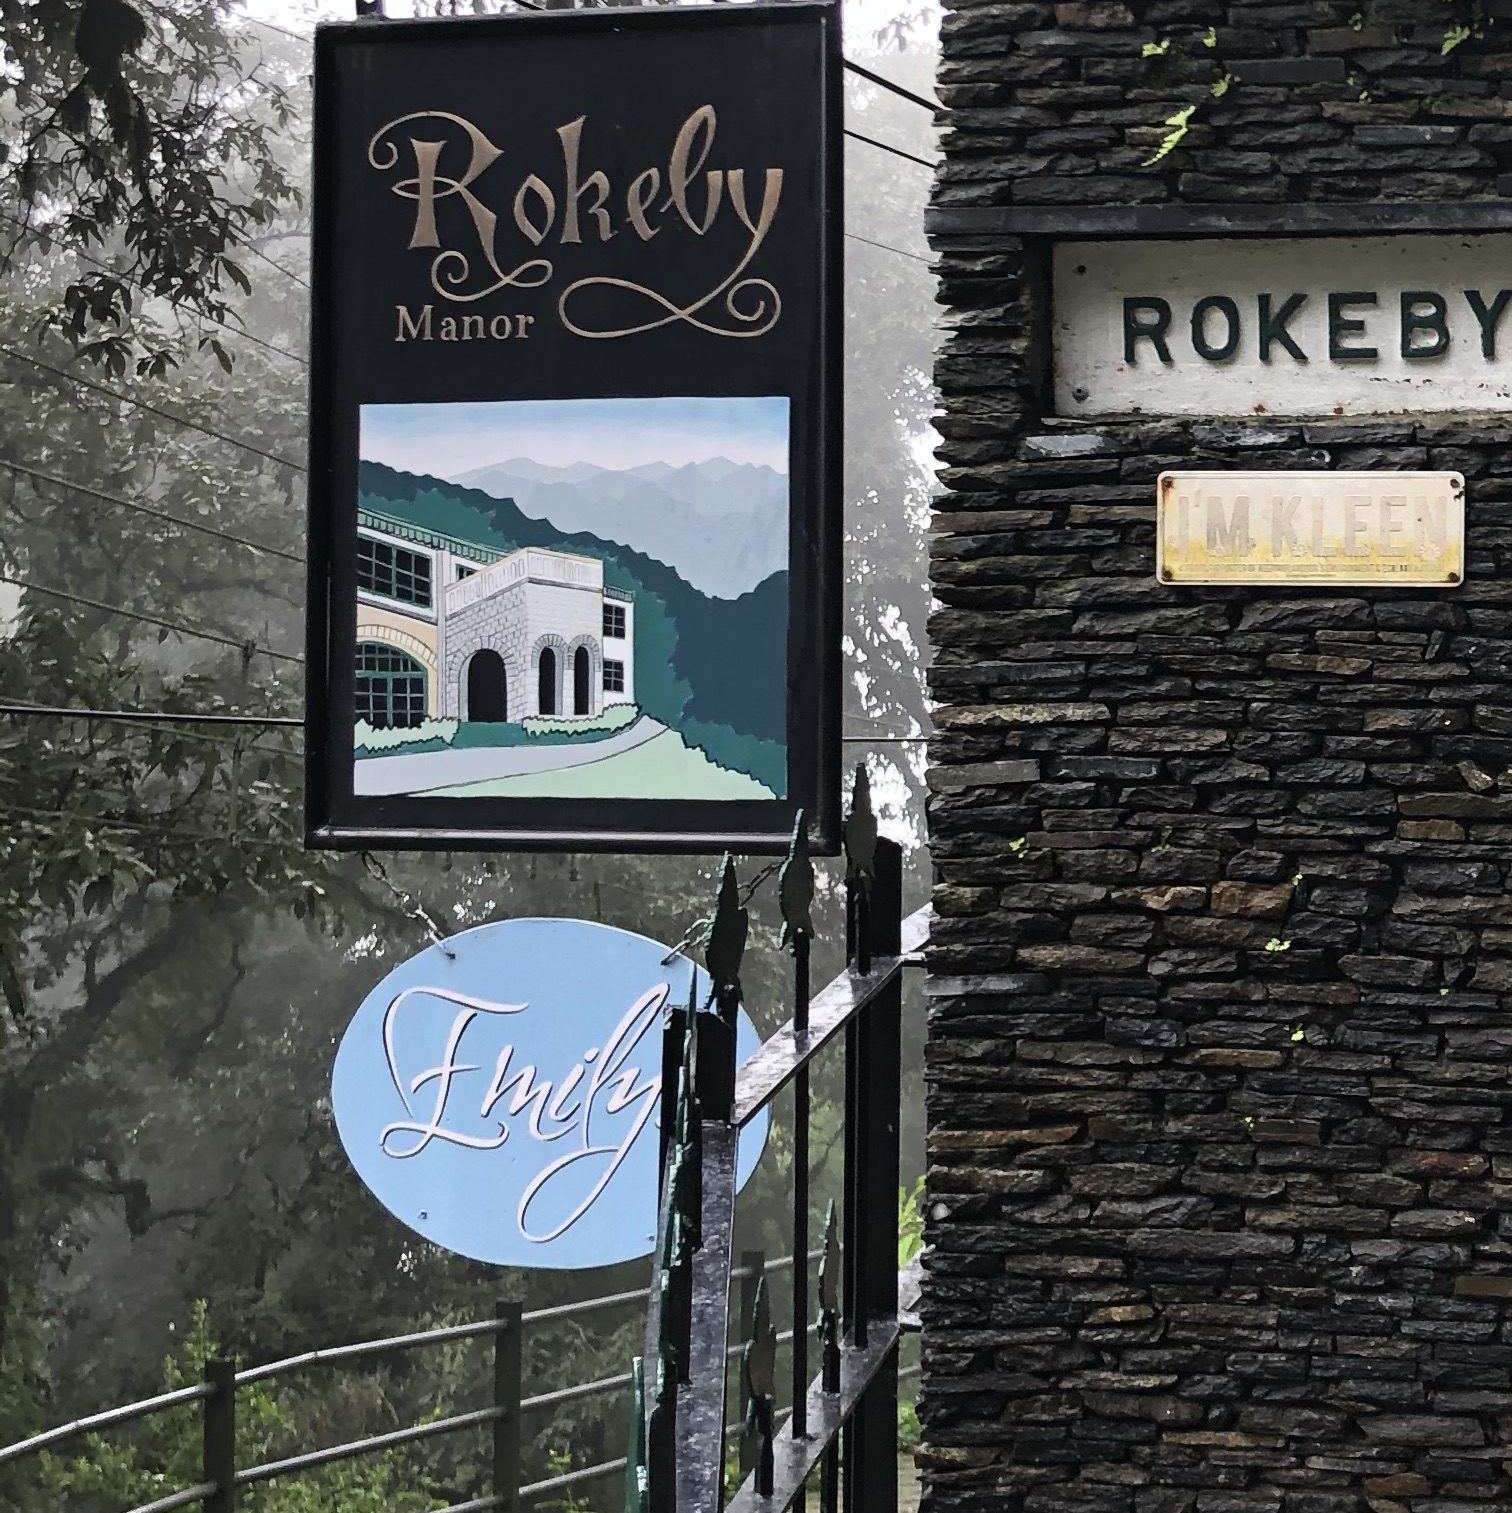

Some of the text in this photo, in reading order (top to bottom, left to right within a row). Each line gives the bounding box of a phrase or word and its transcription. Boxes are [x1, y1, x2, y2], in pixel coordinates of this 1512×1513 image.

[367, 103, 784, 339] Rokeby
[394, 305, 536, 343] Manor
[1177, 489, 1449, 559] I'M KLEEN
[379, 982, 669, 1244] Emily
